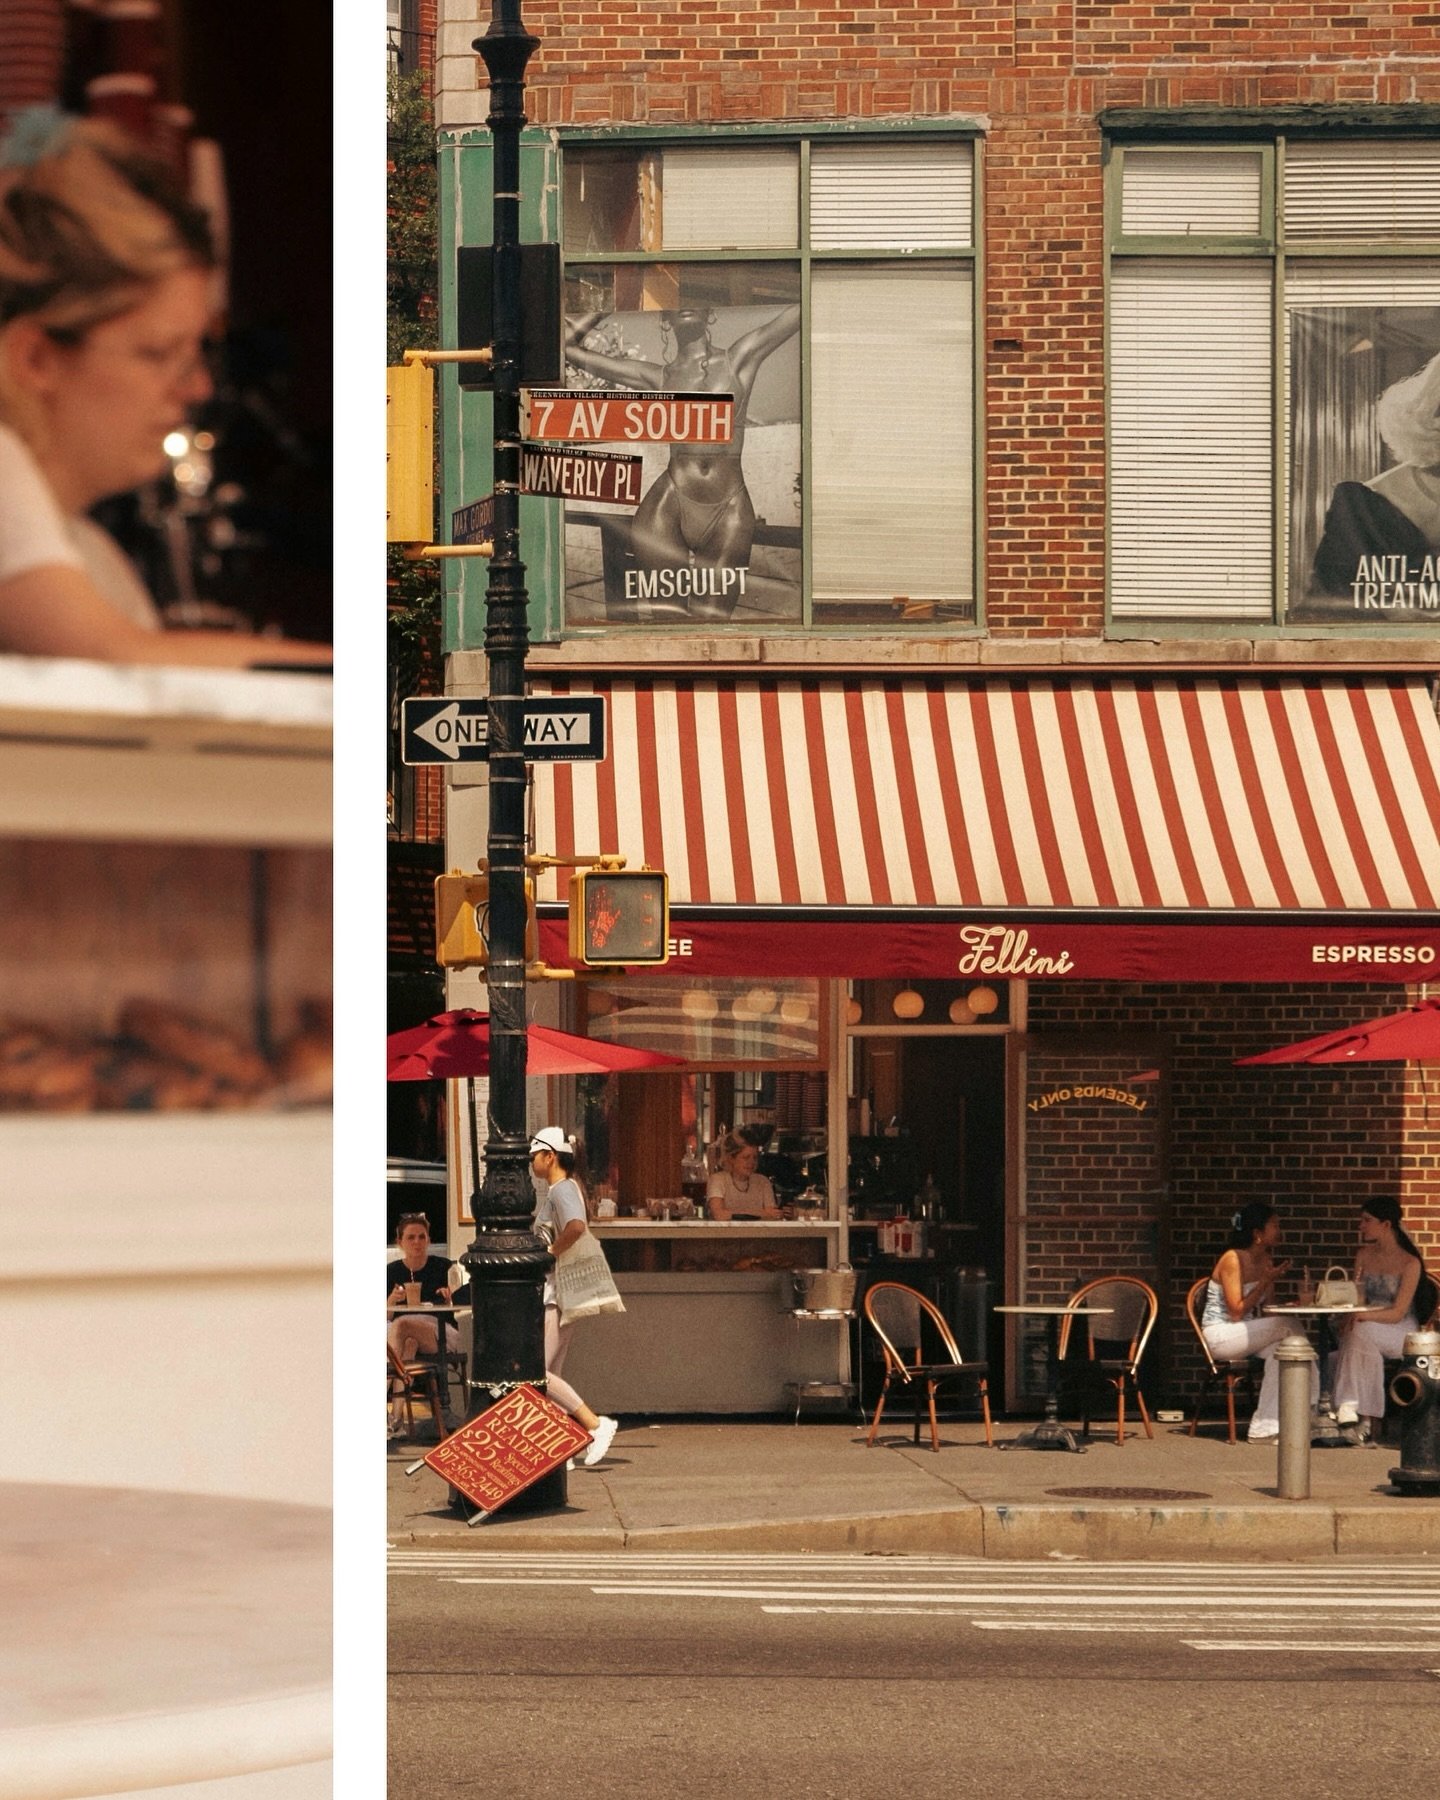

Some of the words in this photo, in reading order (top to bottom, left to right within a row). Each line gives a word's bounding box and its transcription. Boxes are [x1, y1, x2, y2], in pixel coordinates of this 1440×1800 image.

[573, 391, 604, 399] VILLAGE
[606, 392, 640, 400] HISTORIC
[534, 401, 555, 438] 7
[568, 401, 609, 439] AV
[623, 402, 732, 440] SOUTH
[524, 453, 607, 497] WAVERLY
[614, 463, 636, 500] PL
[624, 566, 750, 599] EMSCULPT
[435, 719, 489, 744] ONE
[524, 717, 578, 742] WAY
[958, 925, 1075, 975] Fellini
[1312, 945, 1436, 964] ESPRESSO
[461, 1428, 506, 1461] $25
[484, 1416, 545, 1466] READER
[494, 1392, 580, 1460] PSYCHIC
[434, 1446, 505, 1500] 917-365-2449
